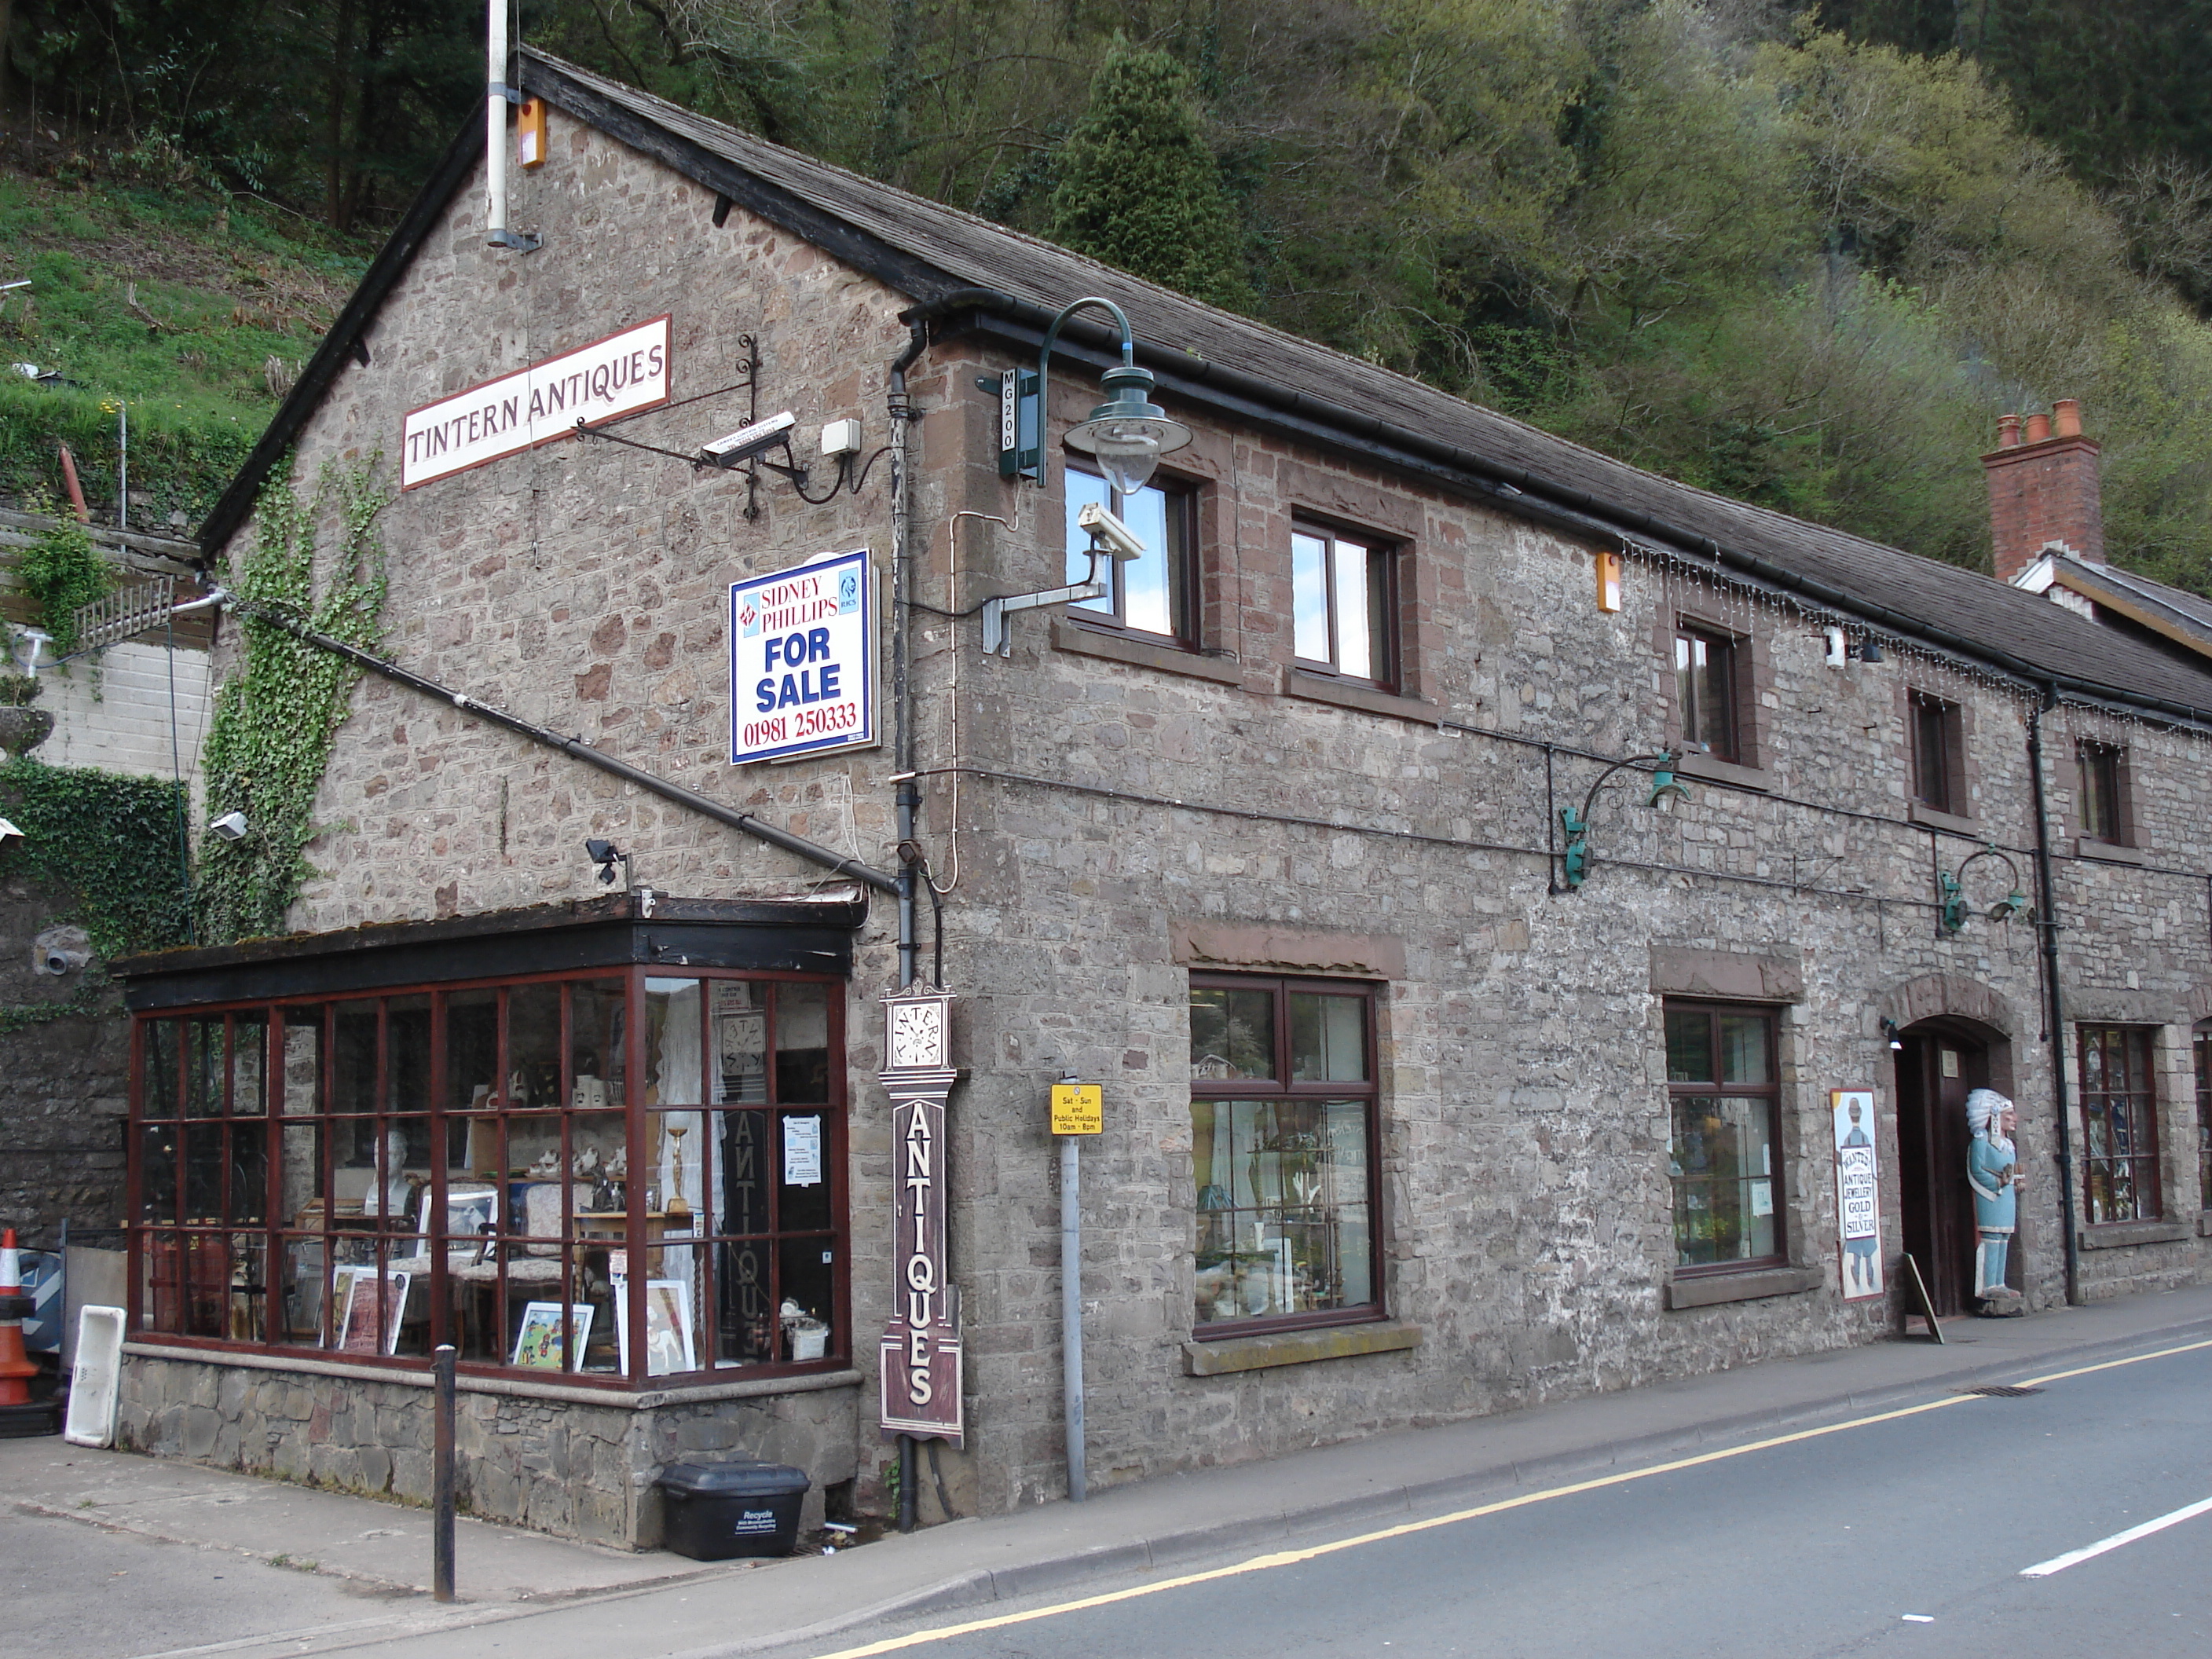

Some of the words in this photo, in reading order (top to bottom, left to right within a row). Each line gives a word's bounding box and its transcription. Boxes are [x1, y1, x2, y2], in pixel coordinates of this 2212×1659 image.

[408, 395, 518, 463] TINTERN
[527, 344, 664, 423] ANTIQUES
[761, 575, 822, 610] SIDNEY
[840, 599, 857, 609] RICS
[762, 596, 838, 633] PHILLIPS
[765, 627, 830, 673] FOR
[756, 663, 841, 713] SALE
[744, 716, 788, 748] 01981
[794, 702, 857, 738] 250333
[1844, 1173, 1872, 1185] ANTIQUE
[1844, 1186, 1871, 1199] JEWELLERY
[1848, 1200, 1871, 1214] GOLD
[1847, 1219, 1874, 1233] SILVER
[906, 1102, 936, 1406] ANTIQUES
[743, 1510, 773, 1521] Recycle
